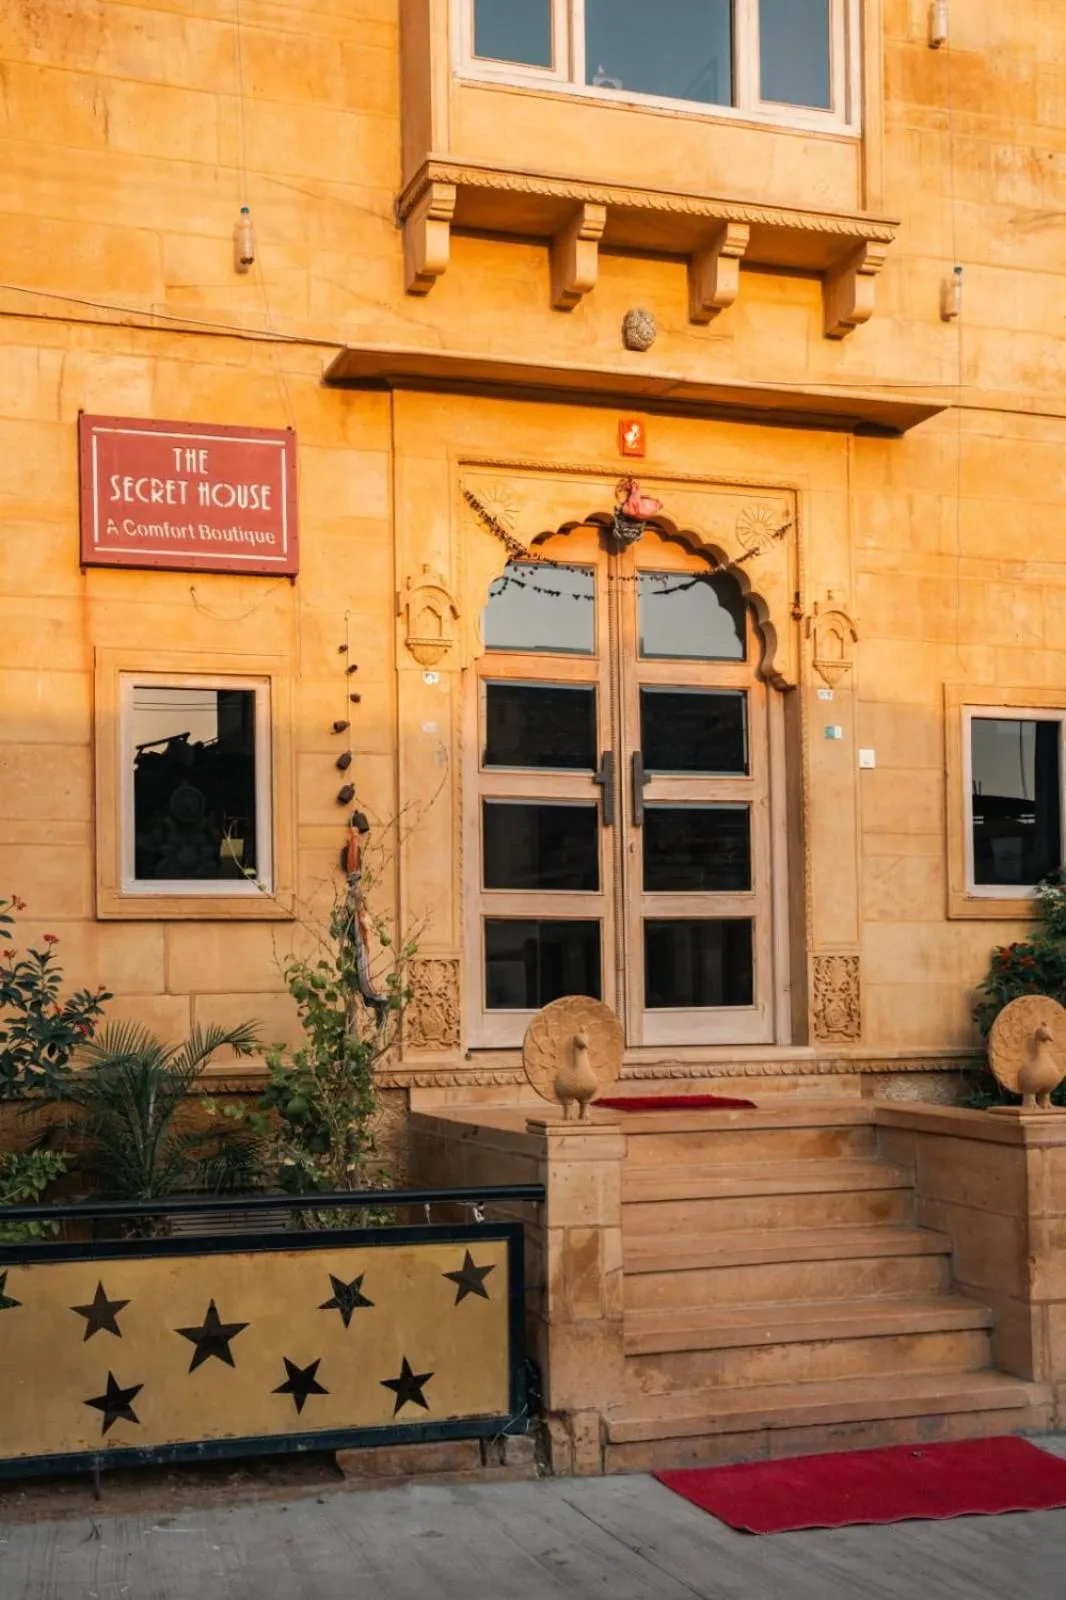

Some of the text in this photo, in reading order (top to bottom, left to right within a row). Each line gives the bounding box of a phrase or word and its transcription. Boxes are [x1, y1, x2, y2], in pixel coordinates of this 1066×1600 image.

[172, 447, 209, 474] THE
[109, 474, 272, 511] SECRET HOUSE
[106, 518, 276, 547] A Comfort Boutique
